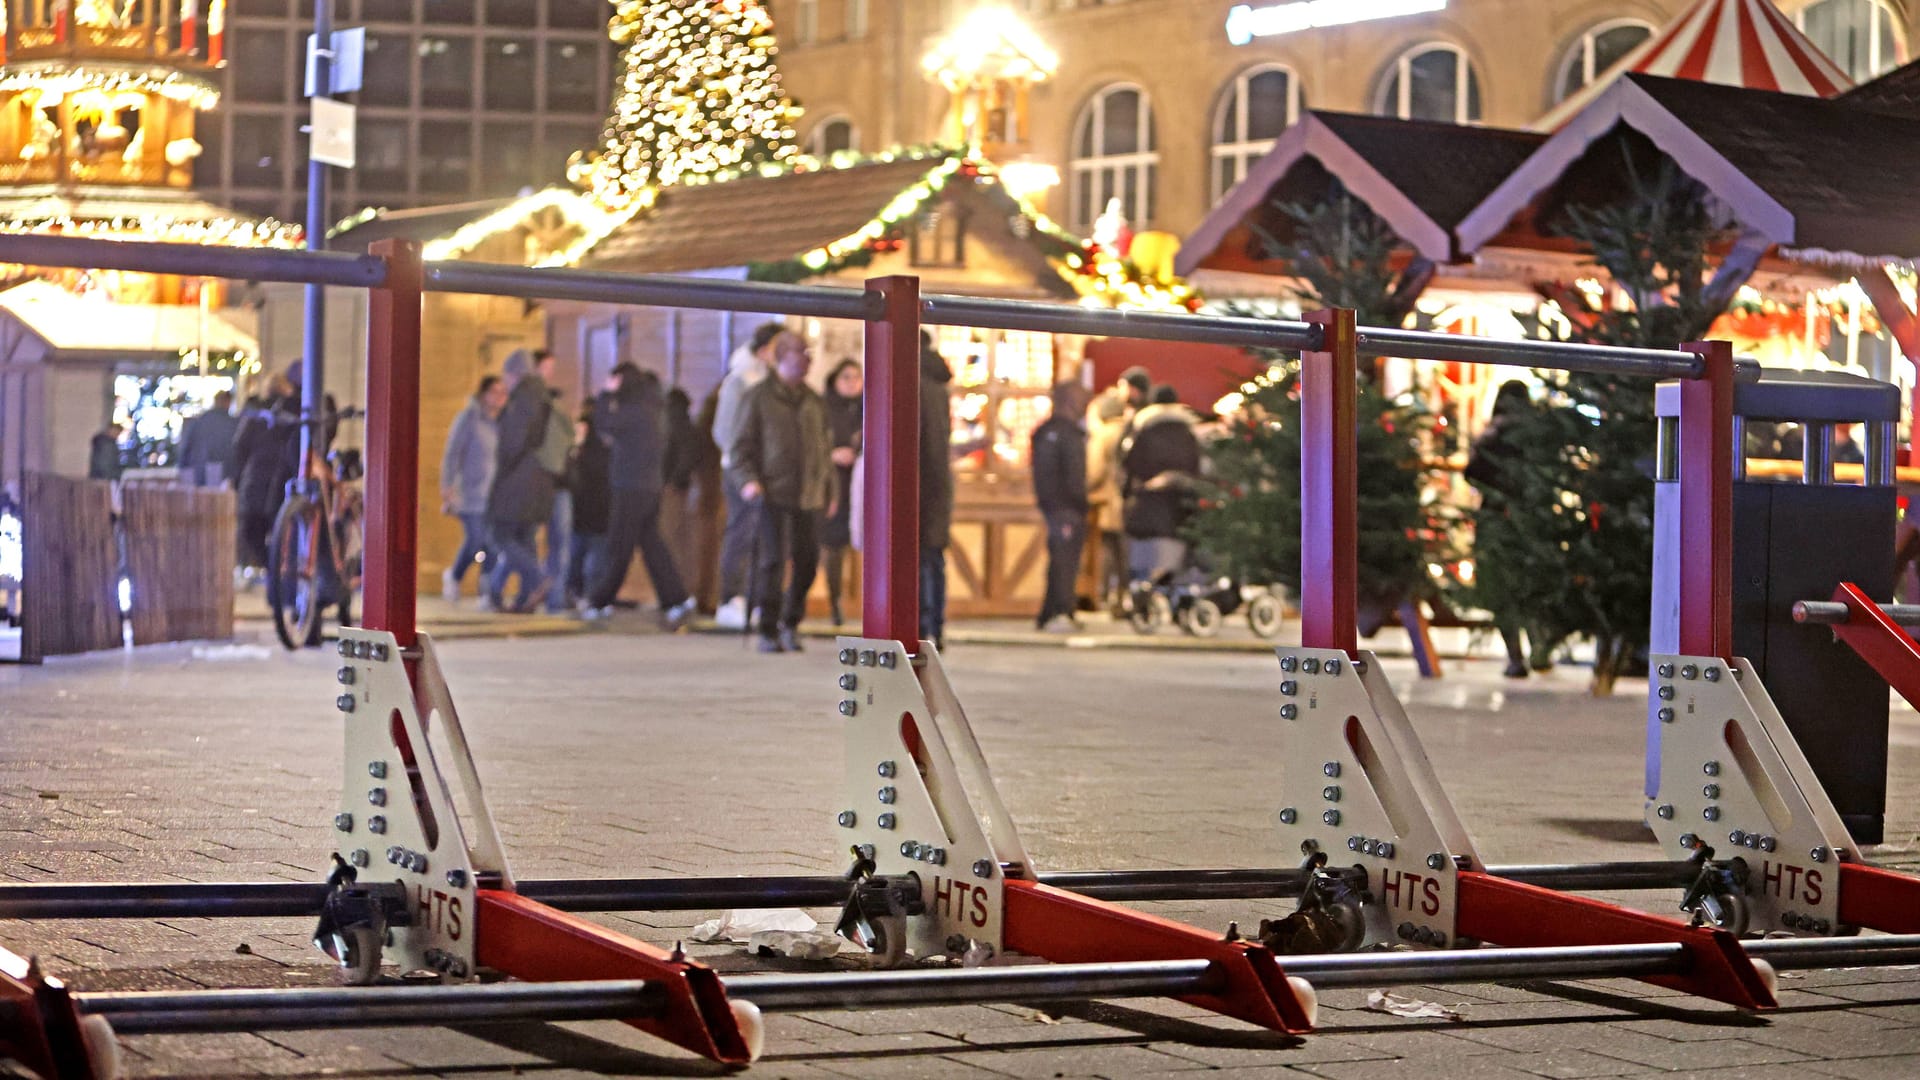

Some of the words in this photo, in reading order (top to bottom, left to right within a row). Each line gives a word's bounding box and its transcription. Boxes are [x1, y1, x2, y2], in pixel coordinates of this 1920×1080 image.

[934, 875, 988, 928] HTS
[1382, 867, 1440, 916] HTS
[1763, 860, 1823, 905] HTS
[417, 884, 462, 941] HTS
